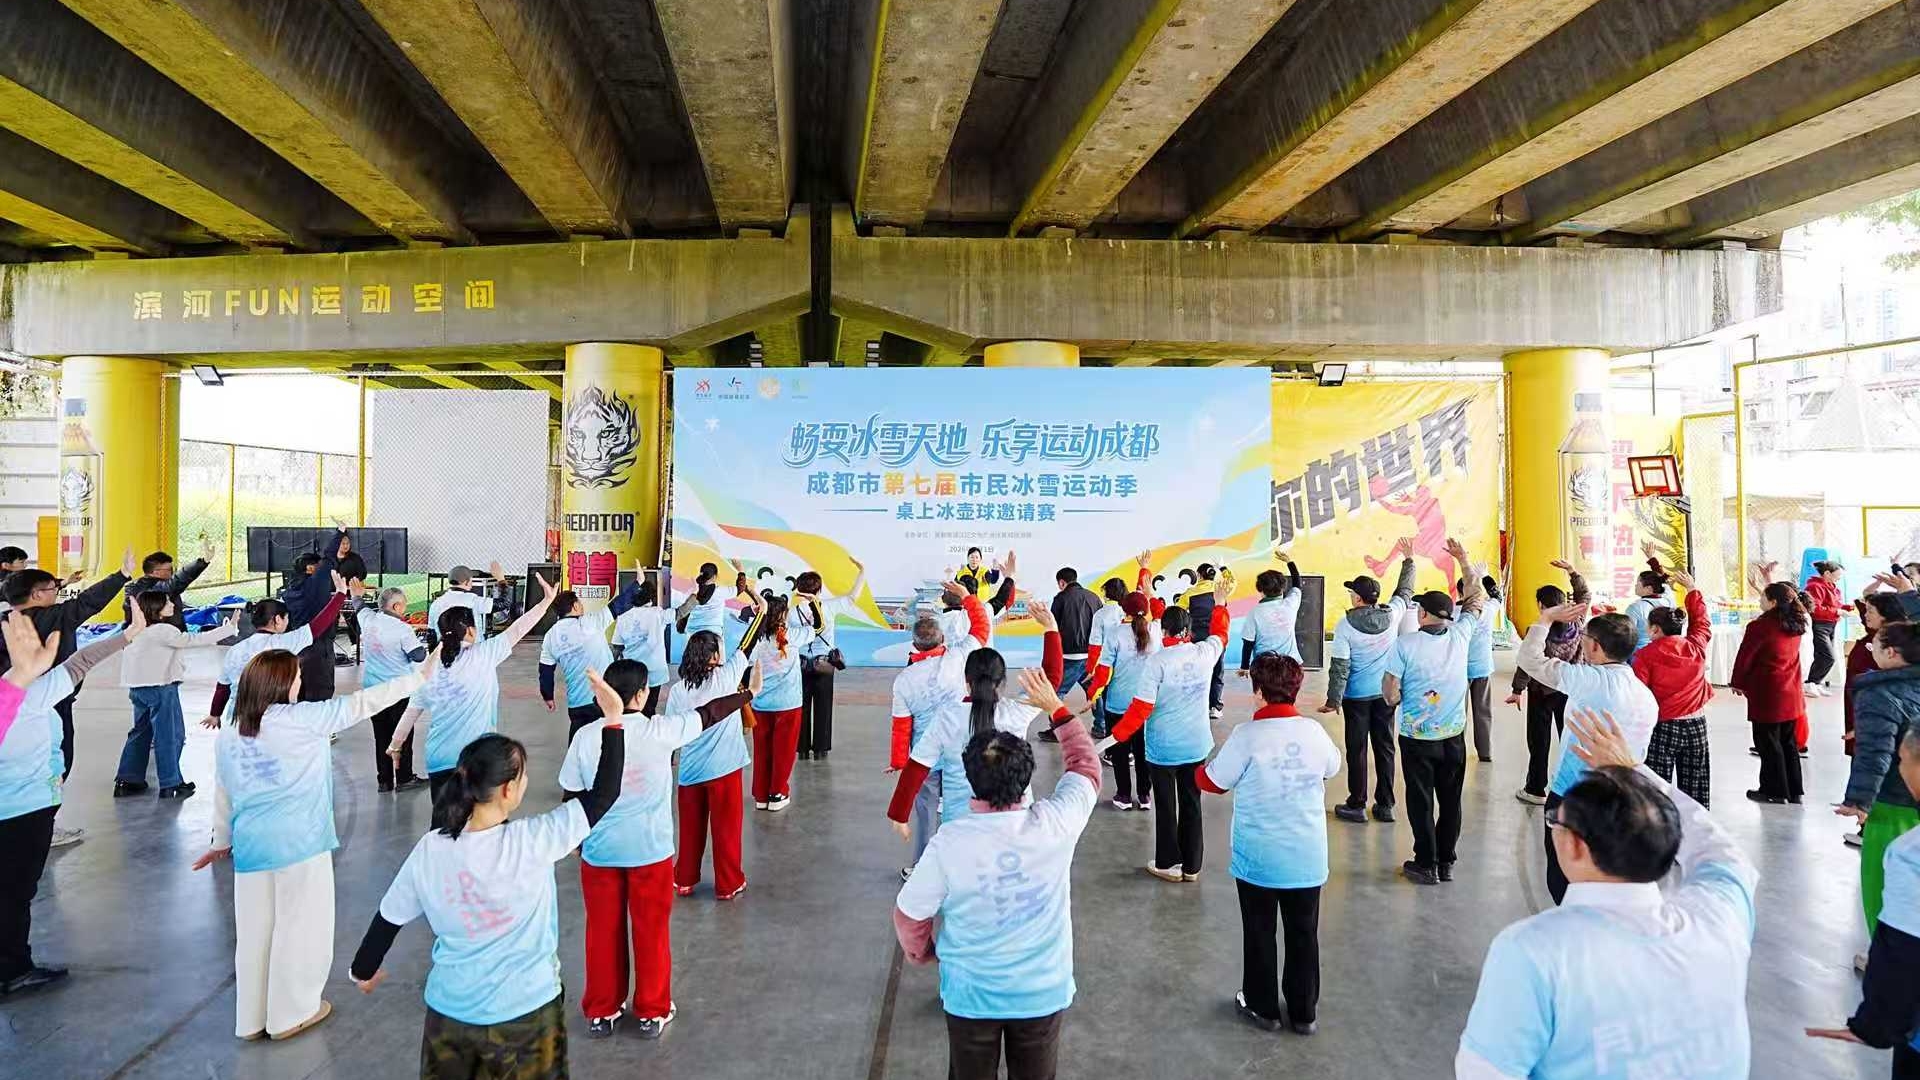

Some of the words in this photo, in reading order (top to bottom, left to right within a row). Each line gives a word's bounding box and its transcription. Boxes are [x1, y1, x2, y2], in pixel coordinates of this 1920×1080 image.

[783, 414, 970, 467] 畅耍冰雪天地
[981, 418, 1159, 468] 乐享运动成都
[806, 472, 1138, 498] 成都市第七届市民冰雪运动季
[896, 502, 1056, 522] 桌上冰壶球邀请赛
